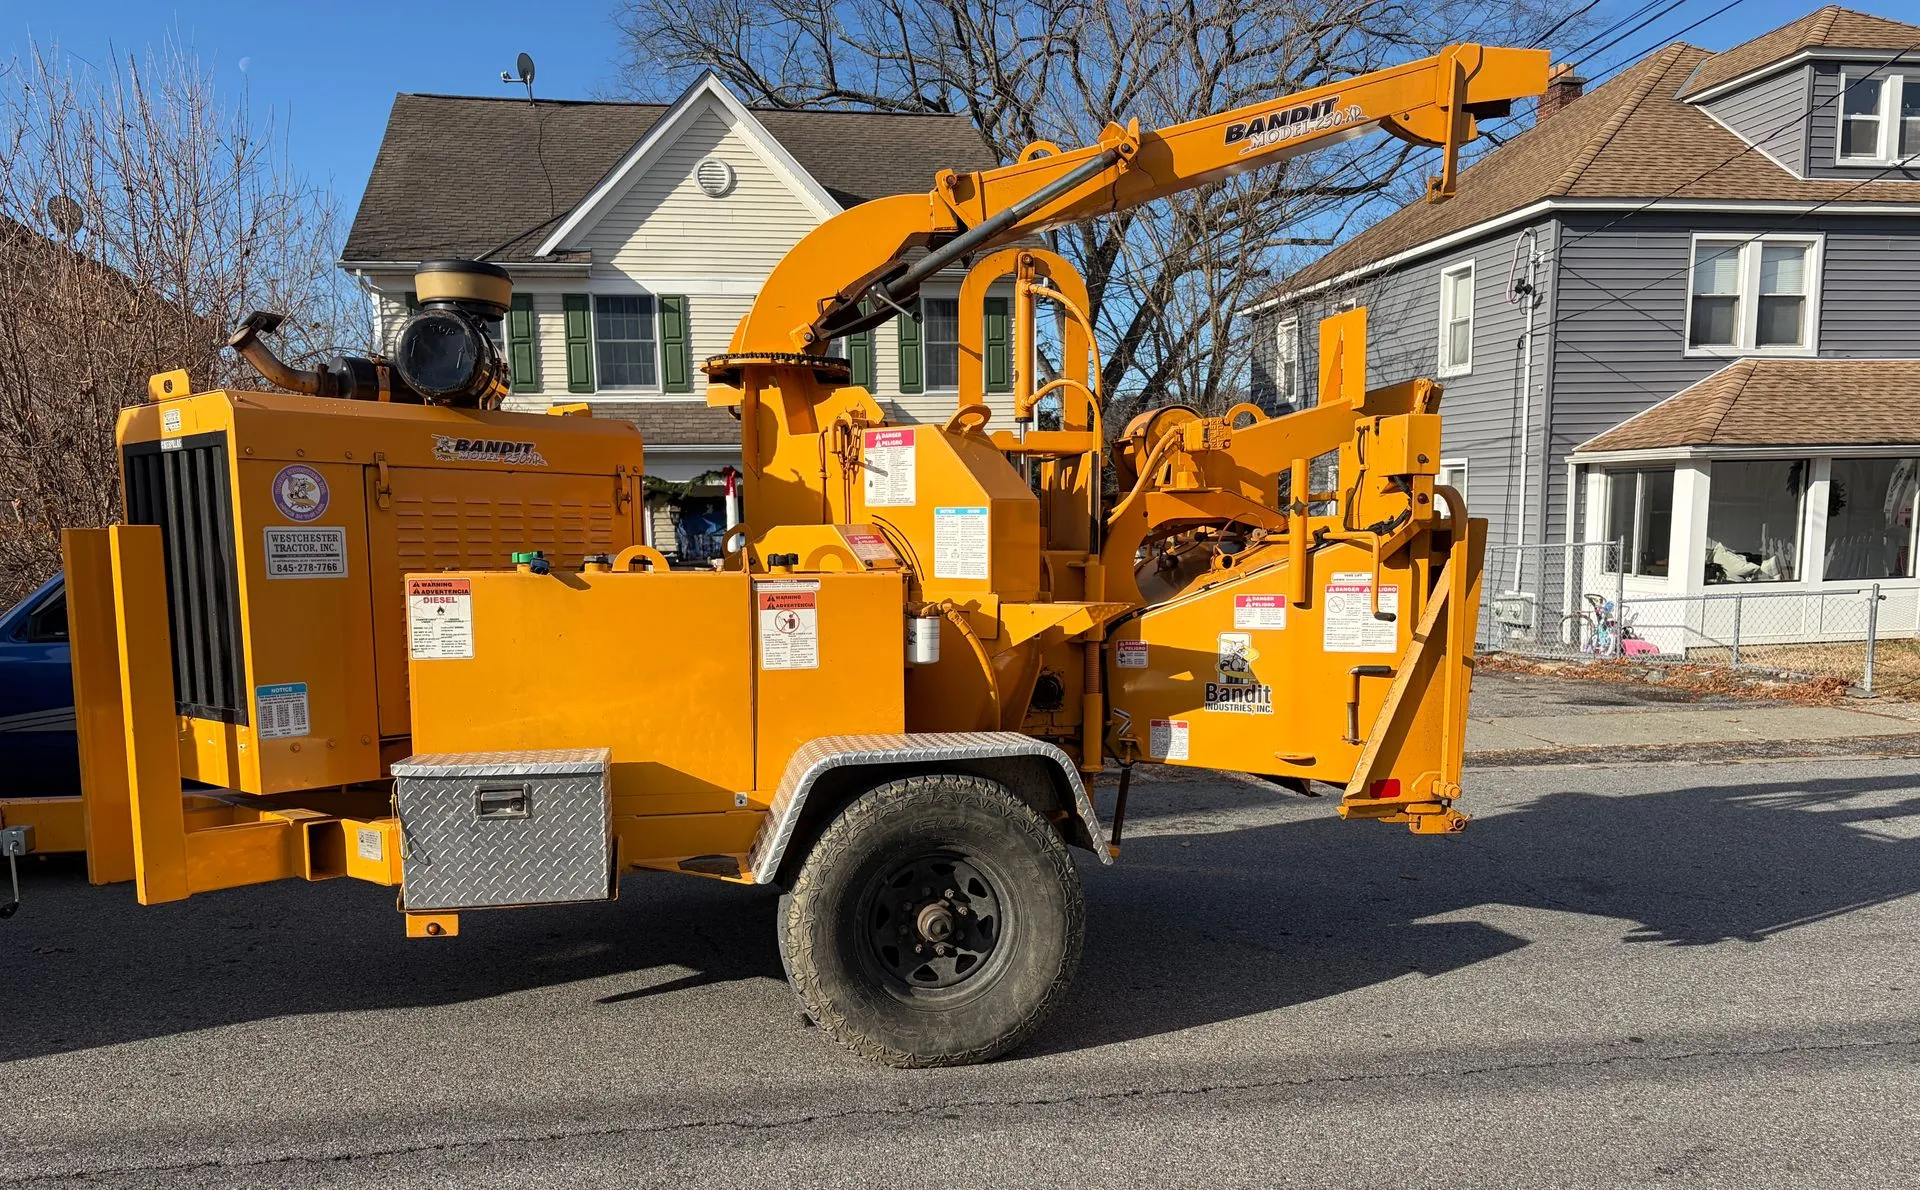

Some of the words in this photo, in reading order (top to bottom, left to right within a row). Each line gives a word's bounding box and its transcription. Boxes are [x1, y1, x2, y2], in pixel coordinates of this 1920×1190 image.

[1225, 96, 1339, 144] BANDIT
[1251, 121, 1311, 148] MODEL
[454, 439, 535, 454] BANDIT
[271, 533, 339, 543] WESTCHESTER
[274, 543, 318, 553] TRACTOR,
[320, 543, 337, 552] INC.
[276, 563, 338, 572] 845-278-7766
[1205, 683, 1271, 704] Bandit
[1205, 703, 1255, 713] INDUSTRIES,
[1257, 704, 1273, 713] INC.
